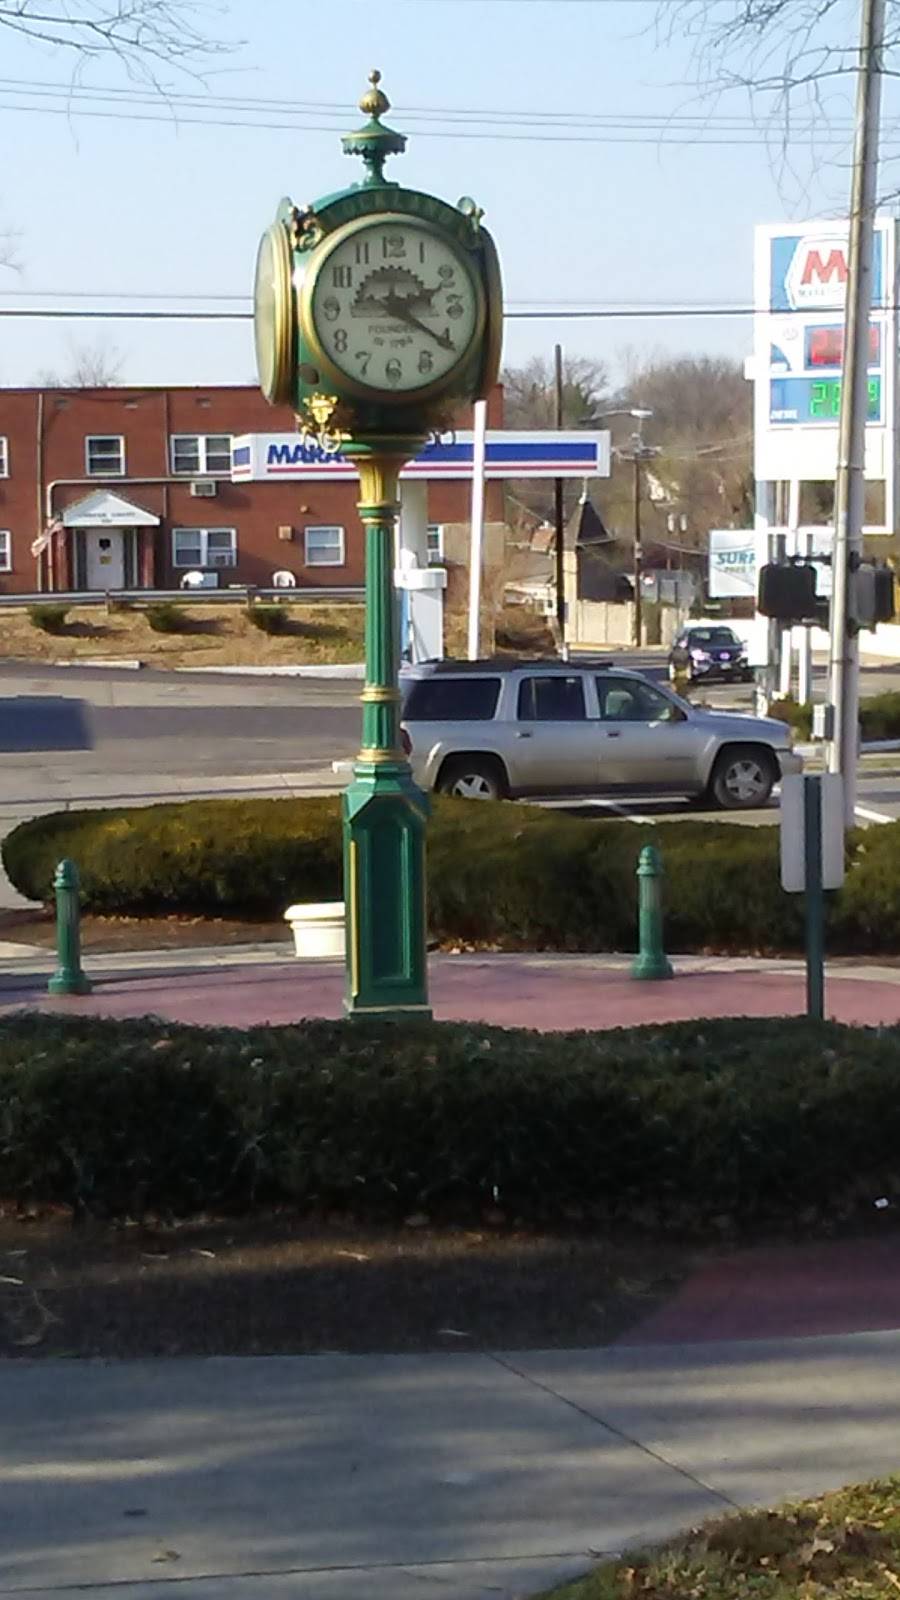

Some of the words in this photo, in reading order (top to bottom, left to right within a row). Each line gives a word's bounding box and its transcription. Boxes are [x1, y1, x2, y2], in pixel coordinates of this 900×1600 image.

[355, 242, 369, 264] 11
[382, 235, 406, 258] 12
[323, 297, 341, 321] 9
[446, 294, 465, 316] 3
[333, 329, 348, 353] 8
[355, 351, 372, 375] 7
[385, 358, 402, 382] 6
[267, 444, 344, 464] MARA
